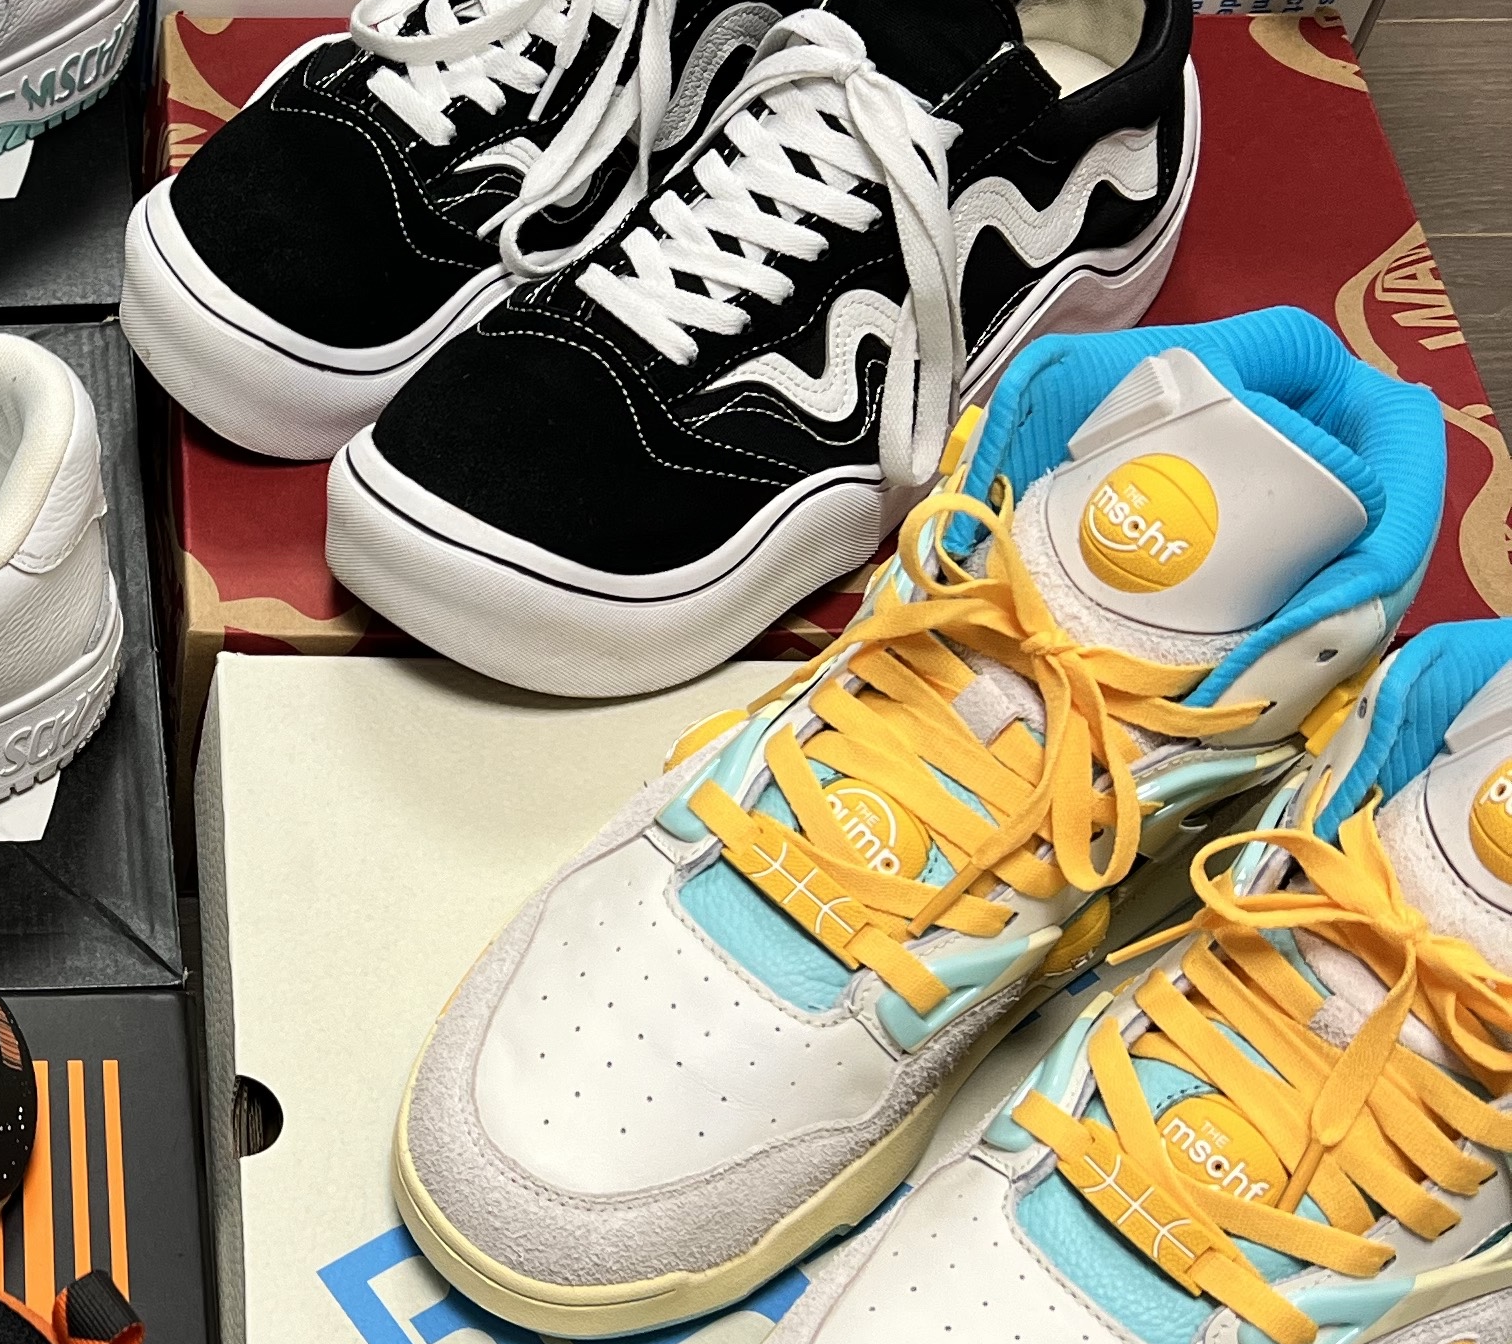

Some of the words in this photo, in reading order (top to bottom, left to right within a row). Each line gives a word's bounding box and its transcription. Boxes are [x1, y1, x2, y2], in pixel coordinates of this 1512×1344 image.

[1093, 483, 1190, 565] mschf
[854, 800, 880, 828] THE
[1162, 1117, 1270, 1202] mschf
[1200, 1120, 1231, 1150] THE
